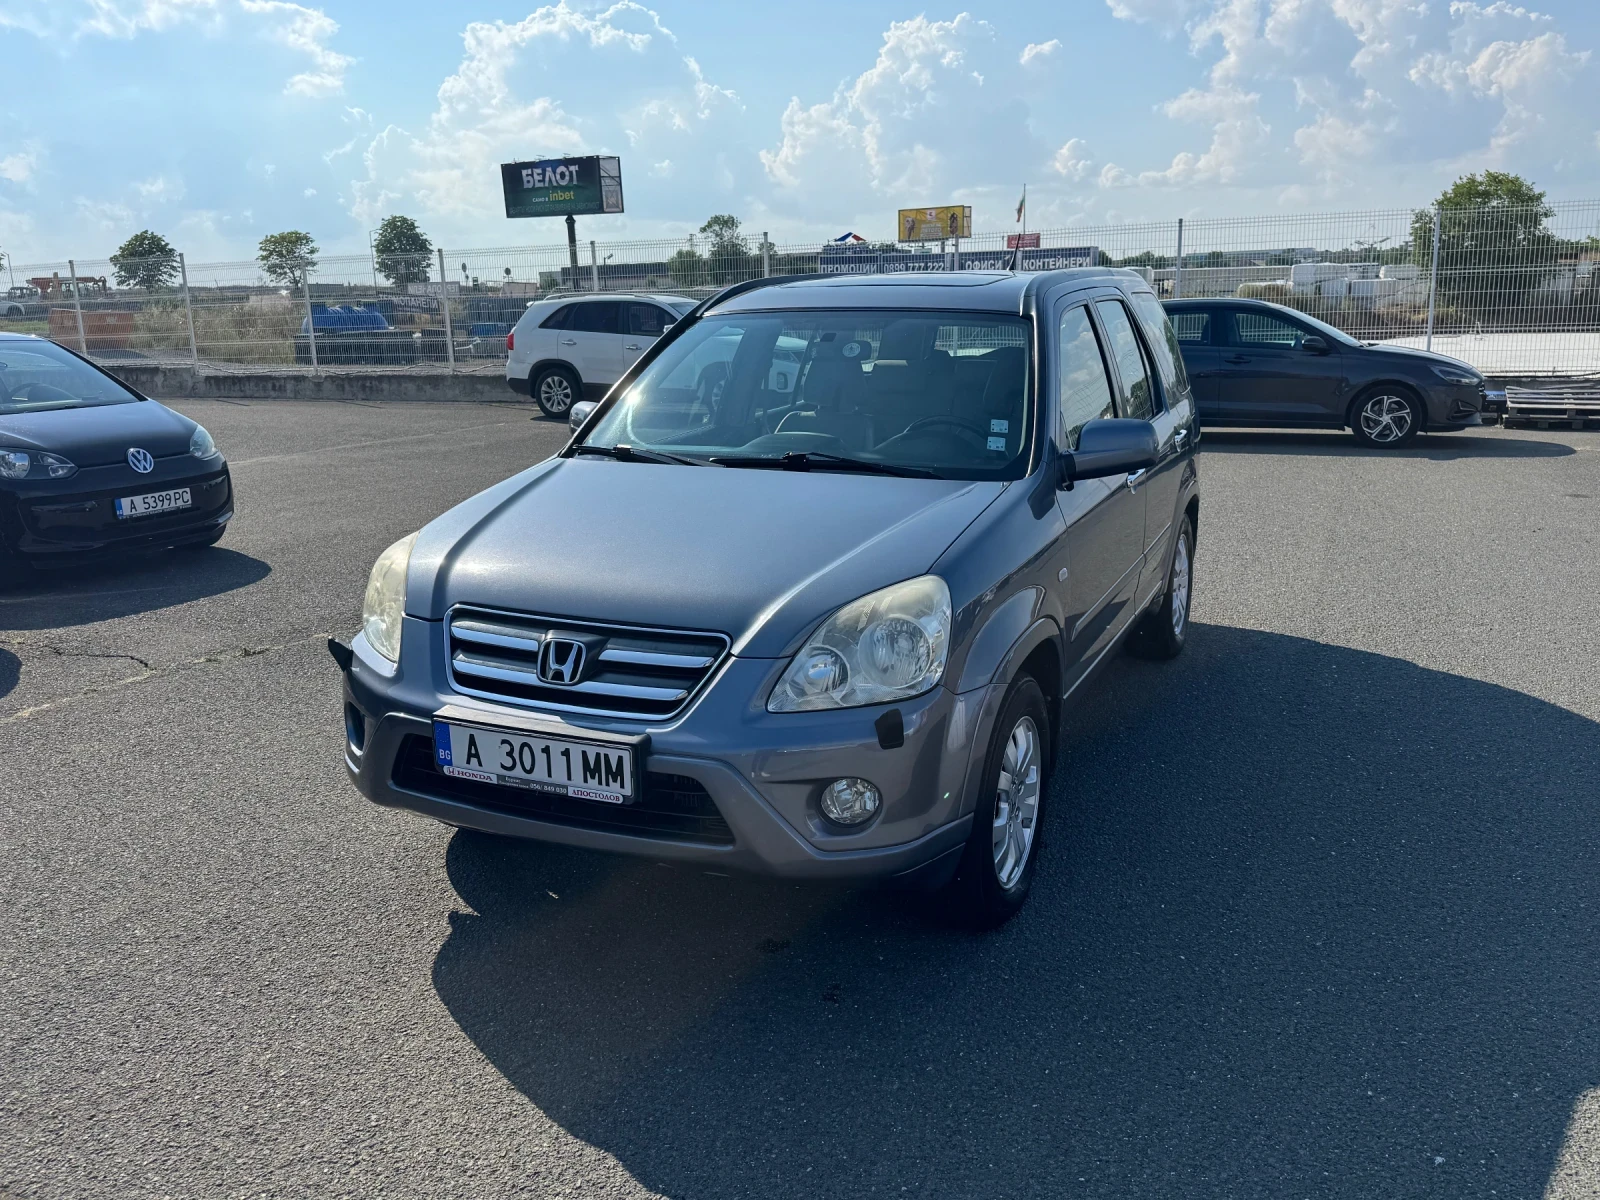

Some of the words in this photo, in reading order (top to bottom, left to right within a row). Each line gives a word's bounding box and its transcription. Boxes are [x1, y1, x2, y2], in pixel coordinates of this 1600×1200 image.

[521, 165, 578, 188] БЕЛОТ
[550, 190, 574, 201] inbet
[821, 264, 877, 273] ПРОМОЦИИ
[884, 263, 904, 273] 0899
[908, 263, 924, 272] 777
[927, 262, 944, 272] 222
[965, 260, 1002, 270] ОФИСИ
[1023, 256, 1090, 270] КОНТЕЙНЕРИ
[130, 499, 137, 512] A
[439, 748, 451, 760] BG
[466, 733, 483, 767] A
[456, 769, 493, 782] HONDA
[572, 789, 621, 802] АПОСТОЛОВ
